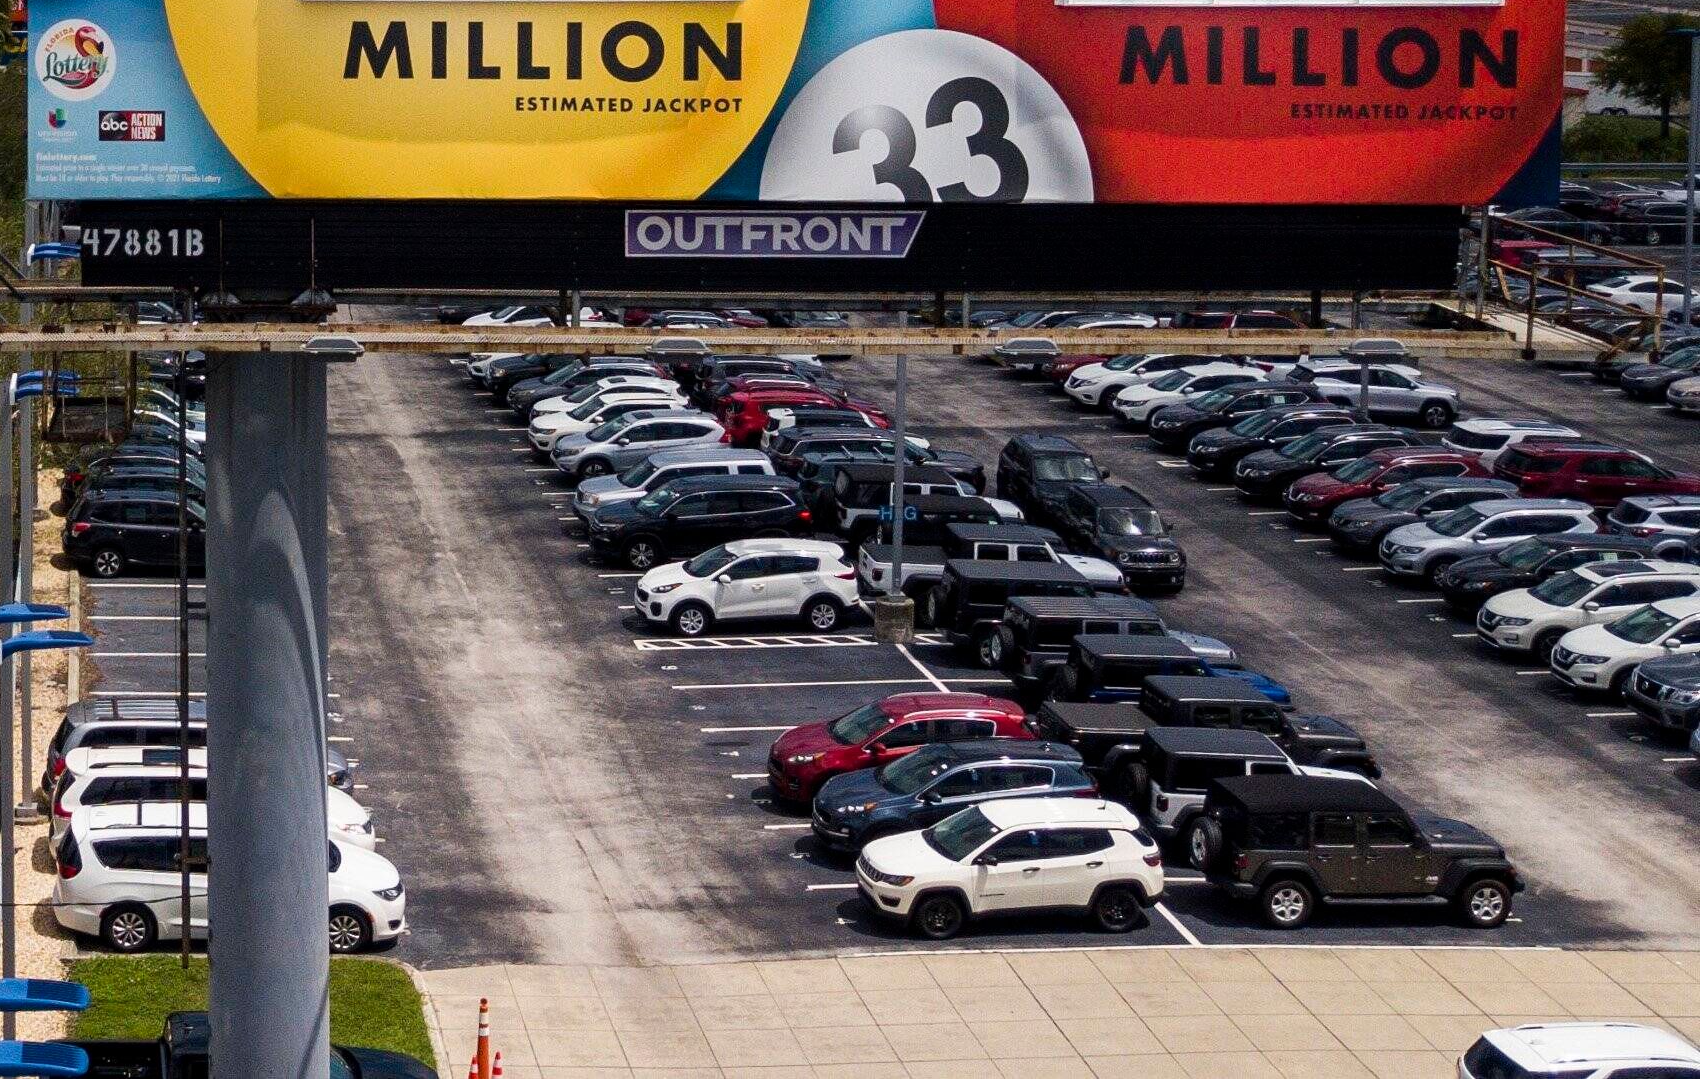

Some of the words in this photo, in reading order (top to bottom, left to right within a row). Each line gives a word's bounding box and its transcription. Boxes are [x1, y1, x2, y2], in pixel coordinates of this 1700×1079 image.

[44, 26, 75, 52] FLORIDA
[343, 20, 743, 83] MILLION
[43, 51, 109, 84] Lottery
[1118, 25, 1519, 90] MILLION
[515, 96, 634, 113] ESTIMATED
[642, 97, 743, 114] JACKPOT
[1290, 103, 1409, 120] ESTIMATED
[1417, 104, 1518, 122] JACKPOT
[101, 116, 128, 132] abc
[131, 113, 163, 126] ACTION
[131, 126, 157, 140] NEWS
[832, 76, 1030, 203] 33
[82, 228, 205, 267] 47881B
[636, 215, 907, 251] OUTFRONT
